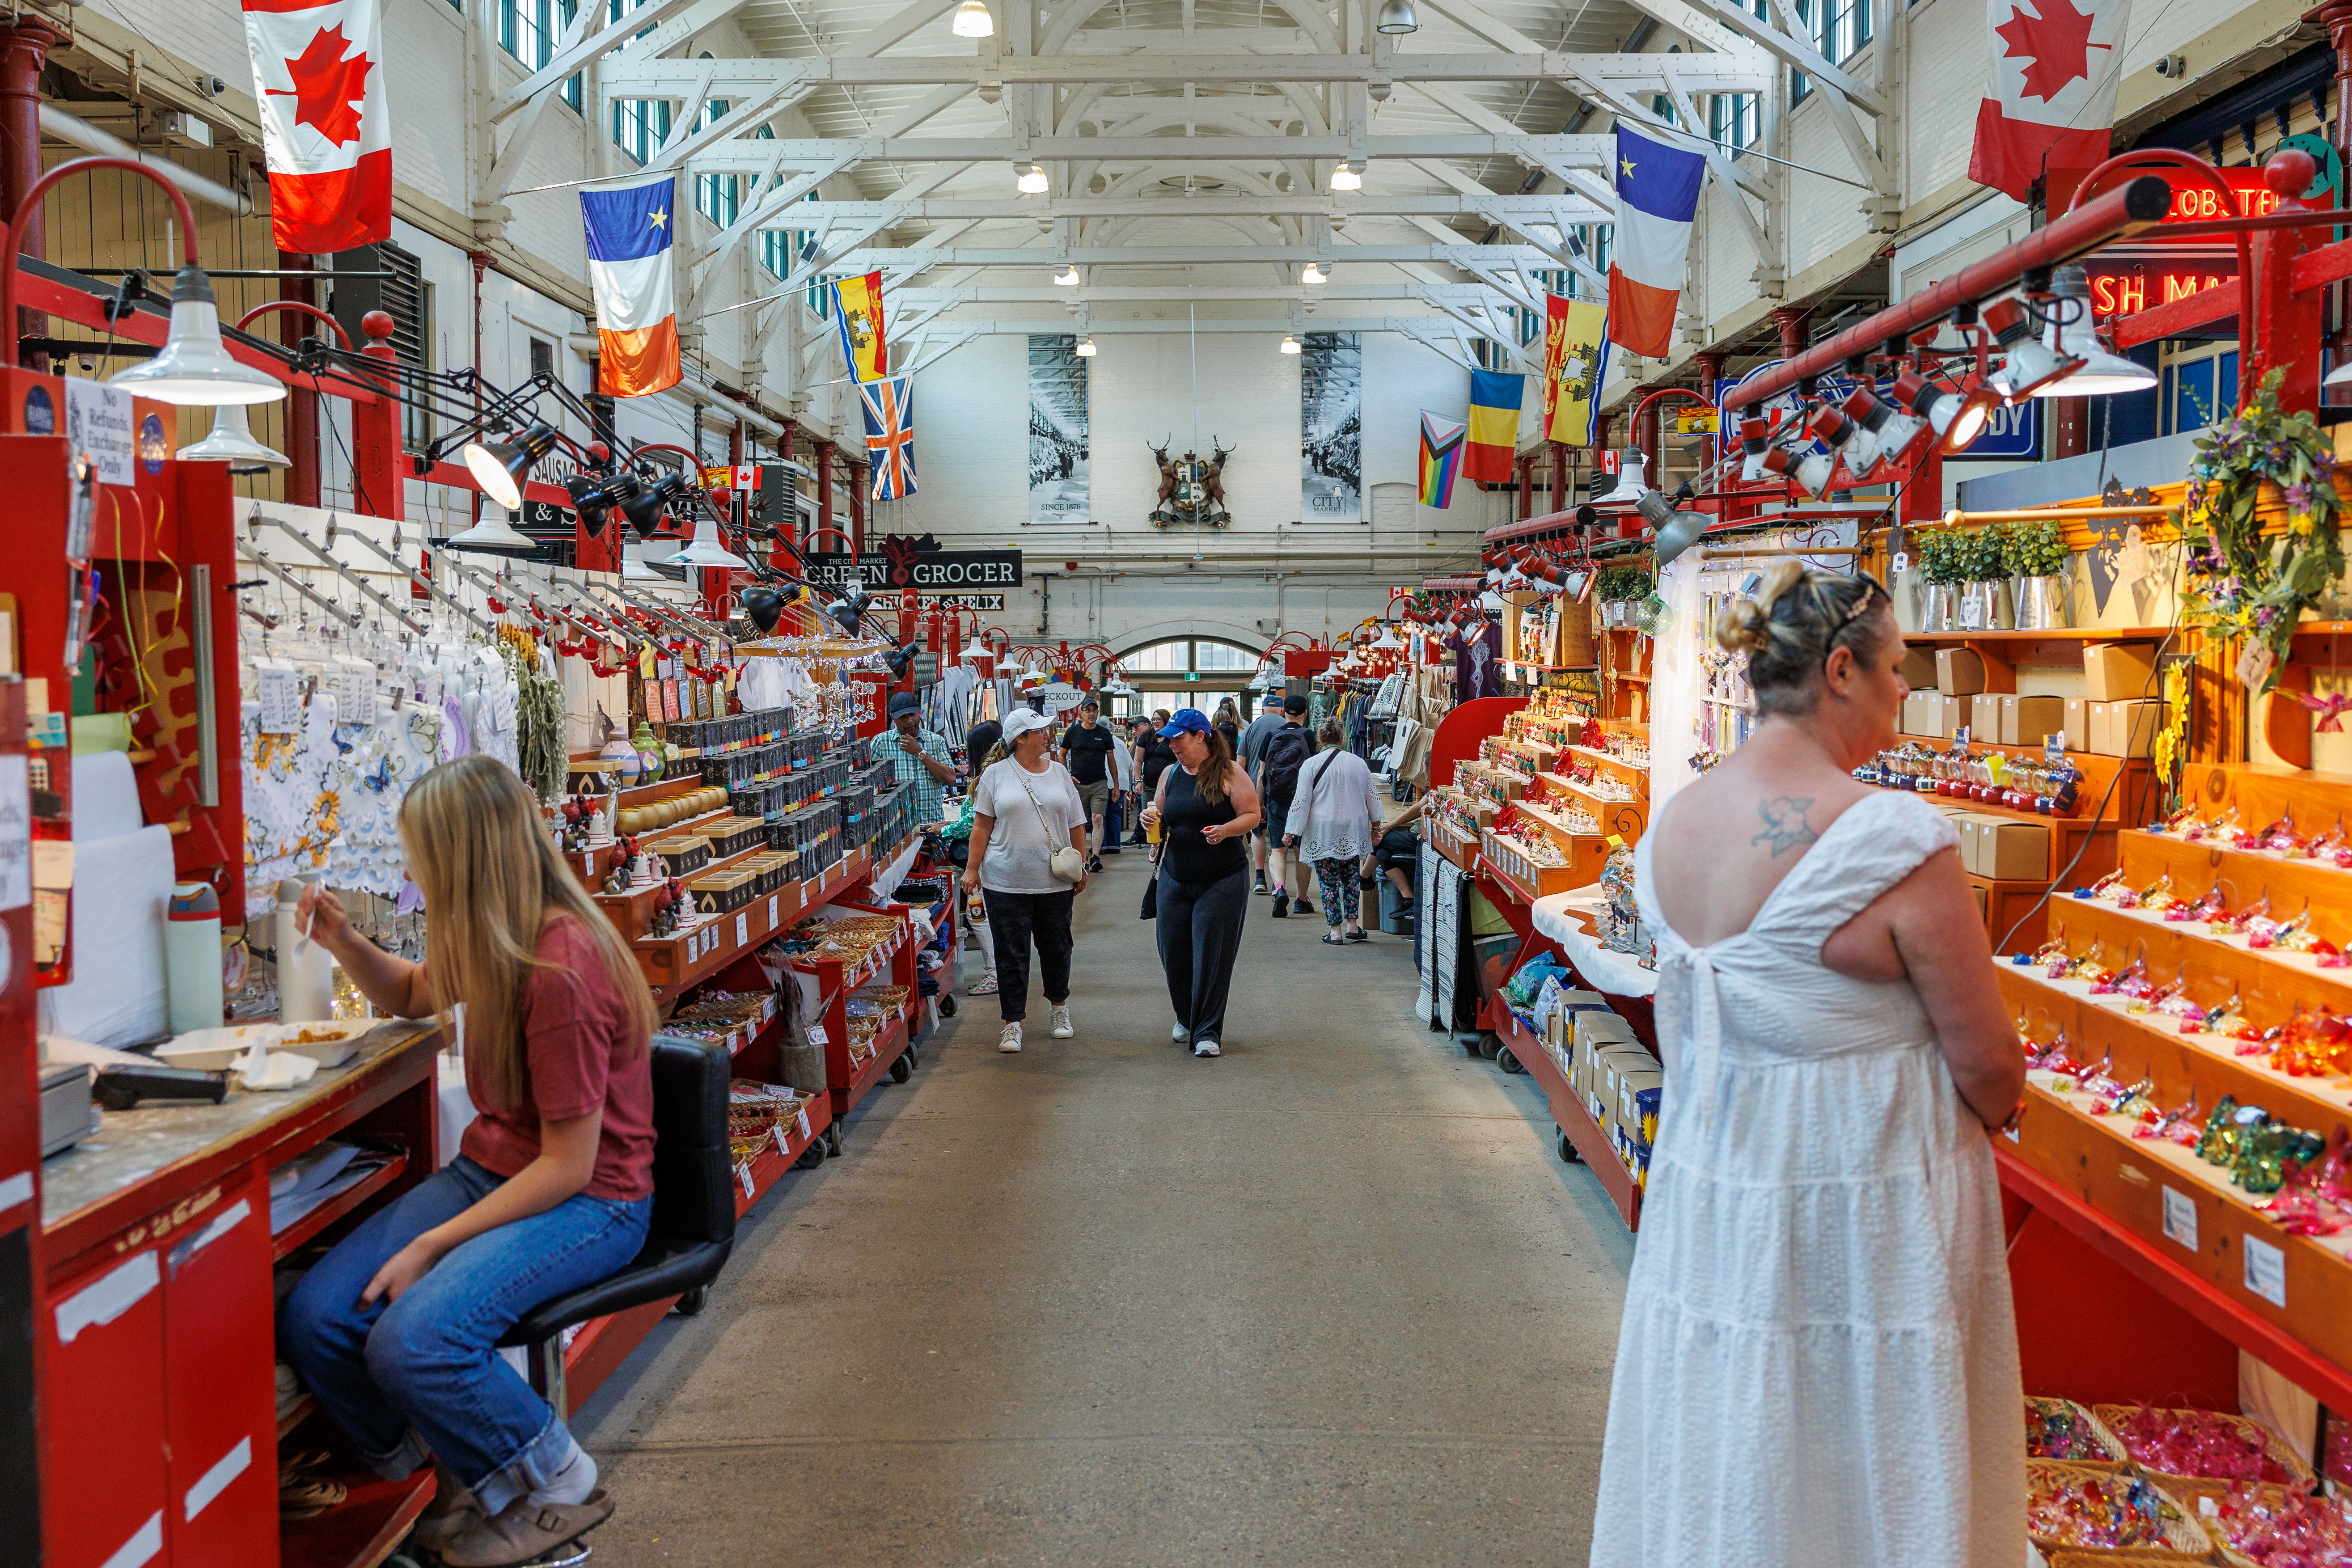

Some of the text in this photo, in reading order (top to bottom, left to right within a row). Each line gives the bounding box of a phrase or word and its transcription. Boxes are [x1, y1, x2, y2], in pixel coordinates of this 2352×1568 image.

[2085, 275, 2145, 315] SH
[102, 388, 118, 407] No
[98, 455, 122, 479] Only
[1312, 497, 1344, 507] CITY
[536, 503, 552, 521] &
[805, 563, 1015, 584] GREEN GROCER
[943, 596, 956, 609] BY
[958, 596, 1001, 610] FELIX
